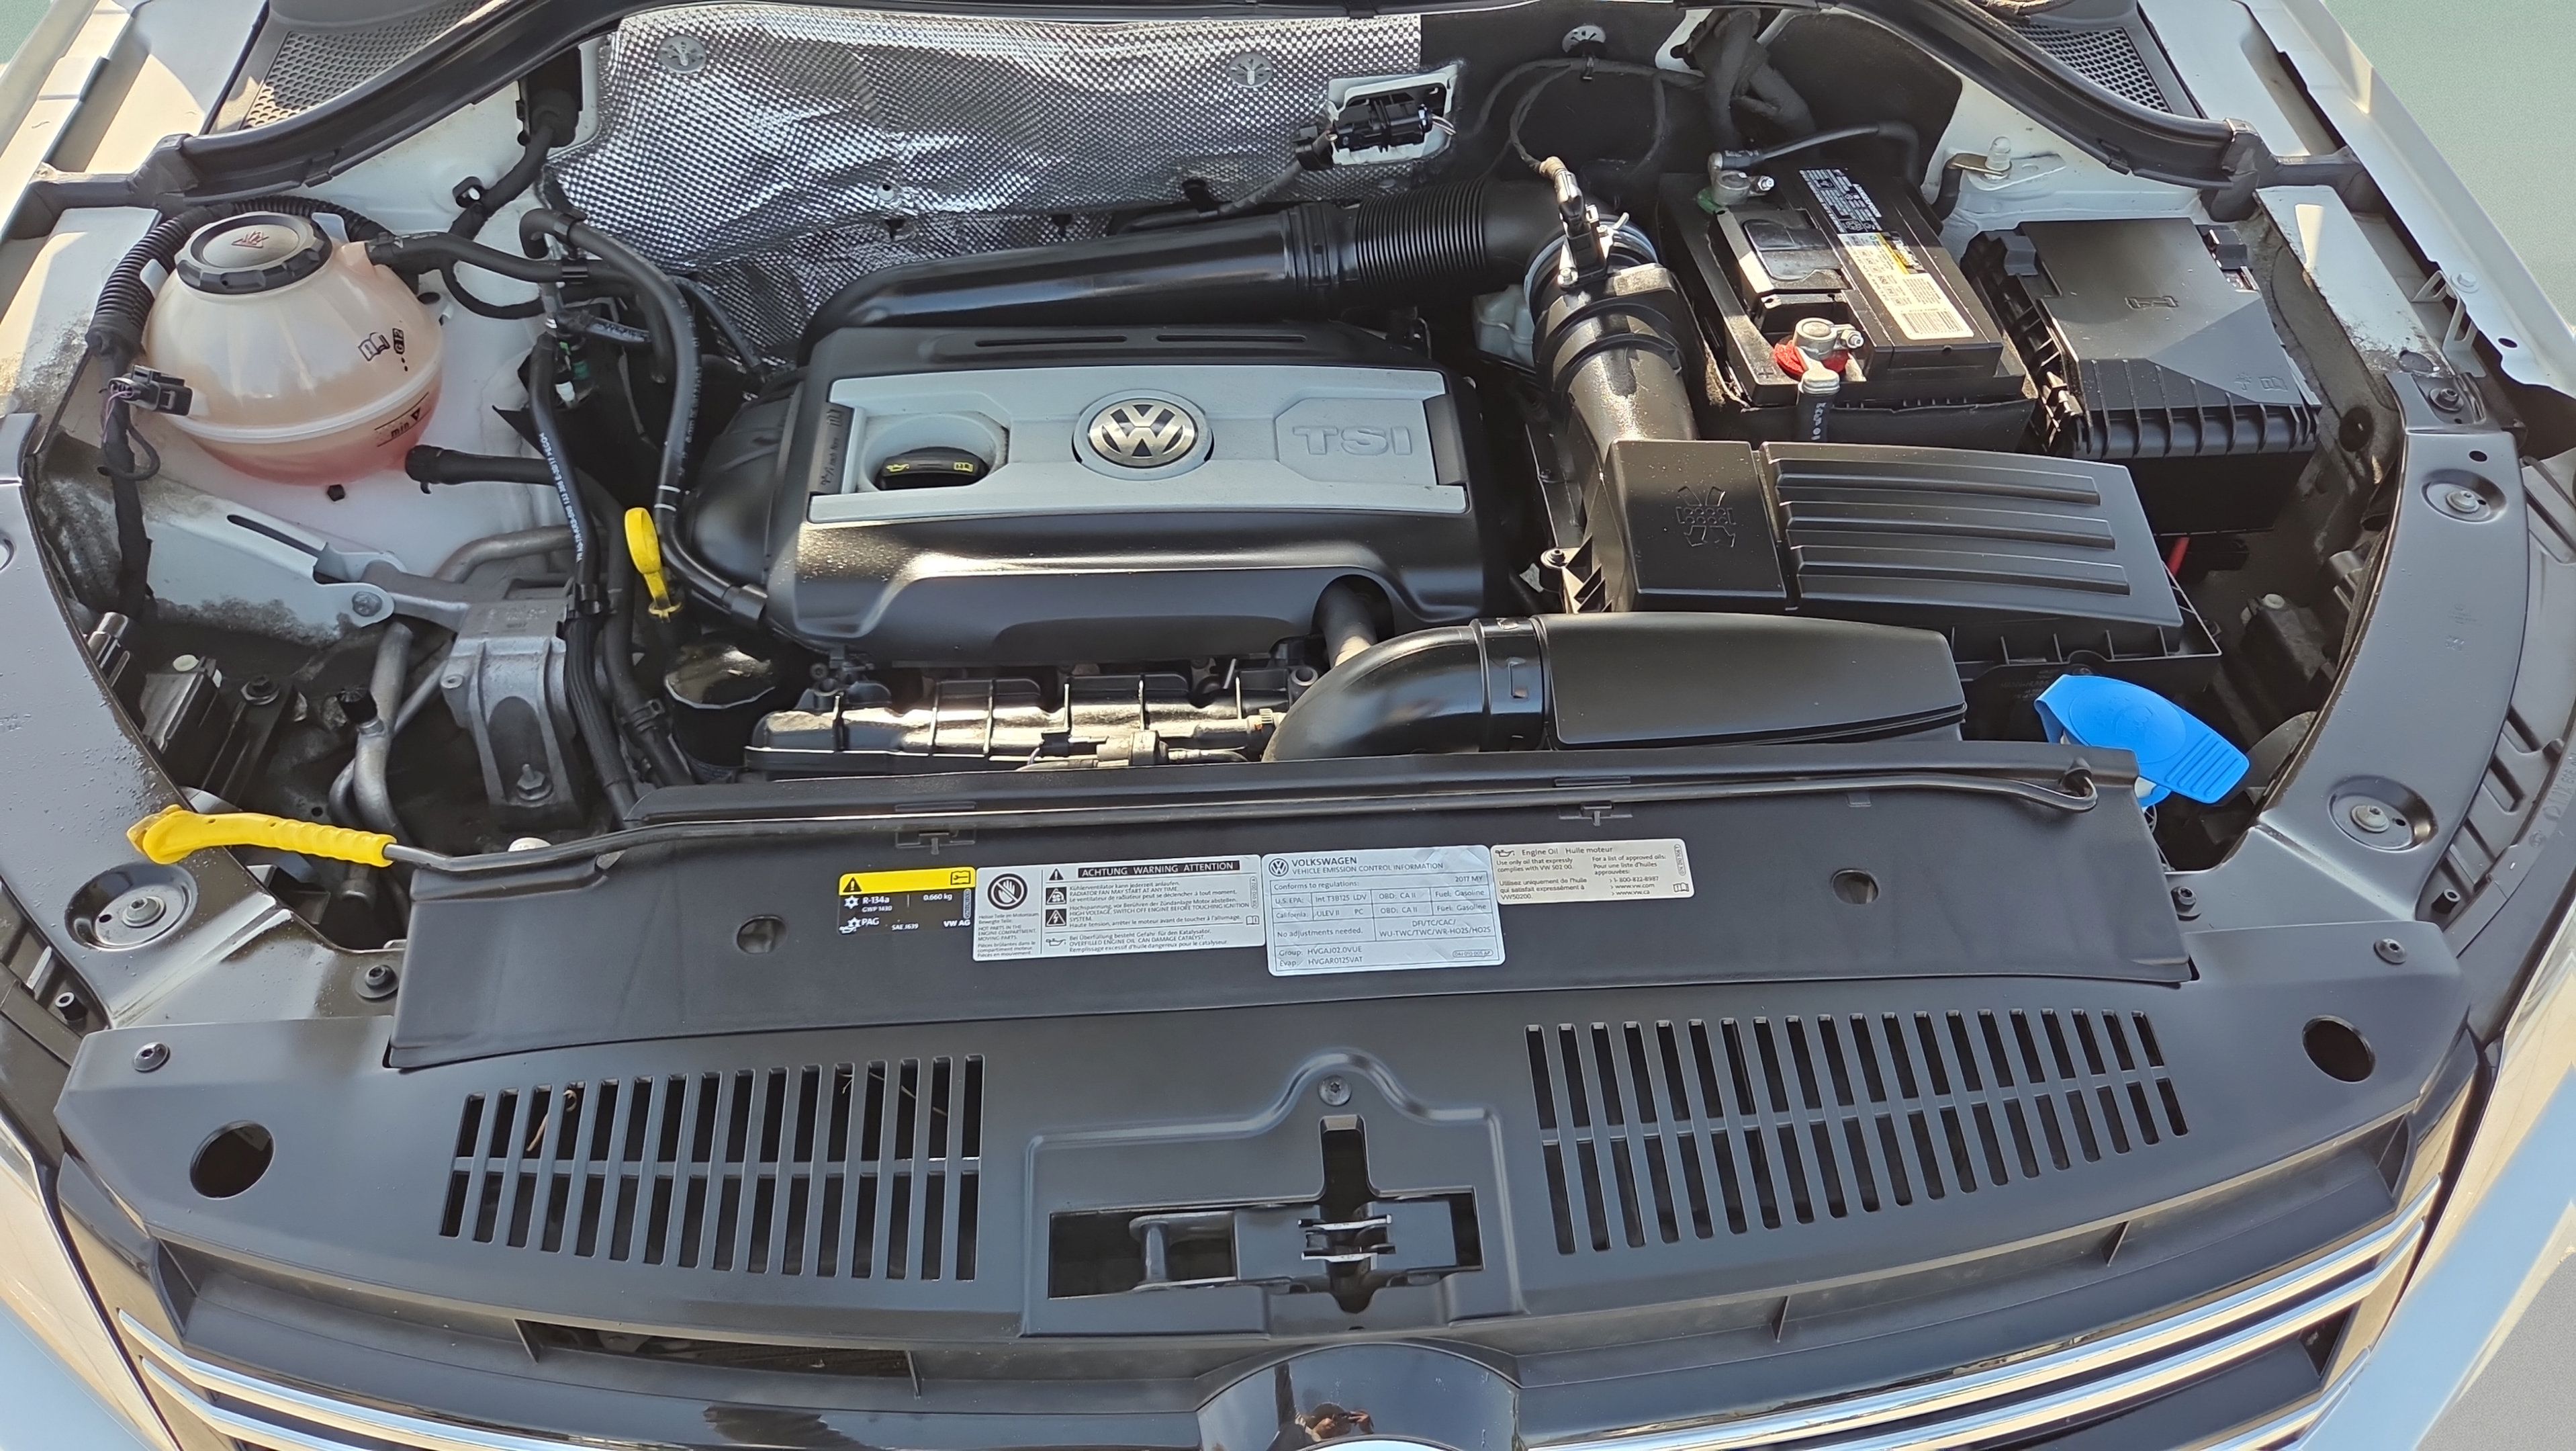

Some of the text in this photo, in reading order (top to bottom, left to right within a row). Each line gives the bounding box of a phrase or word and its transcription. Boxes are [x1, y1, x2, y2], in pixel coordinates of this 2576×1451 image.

[390, 421, 410, 438] min
[1292, 425, 1413, 456] TSI
[1521, 848, 1547, 857] Engine
[1291, 856, 1358, 867] VOLKSWAGEN
[1393, 863, 1444, 871] INFORMATION
[1082, 861, 1234, 877] ACHTUNG WARNING ATTENTION
[1273, 883, 1308, 891] Conforms
[1318, 880, 1359, 889] regulations:
[862, 896, 890, 904] R-134a
[943, 893, 953, 902] kg
[1454, 889, 1485, 897] Gasoline
[1456, 904, 1487, 912] Gasoline
[860, 917, 972, 928] PAG VW AG
[1289, 929, 1334, 938] adjustments
[1334, 926, 1363, 935] needed.
